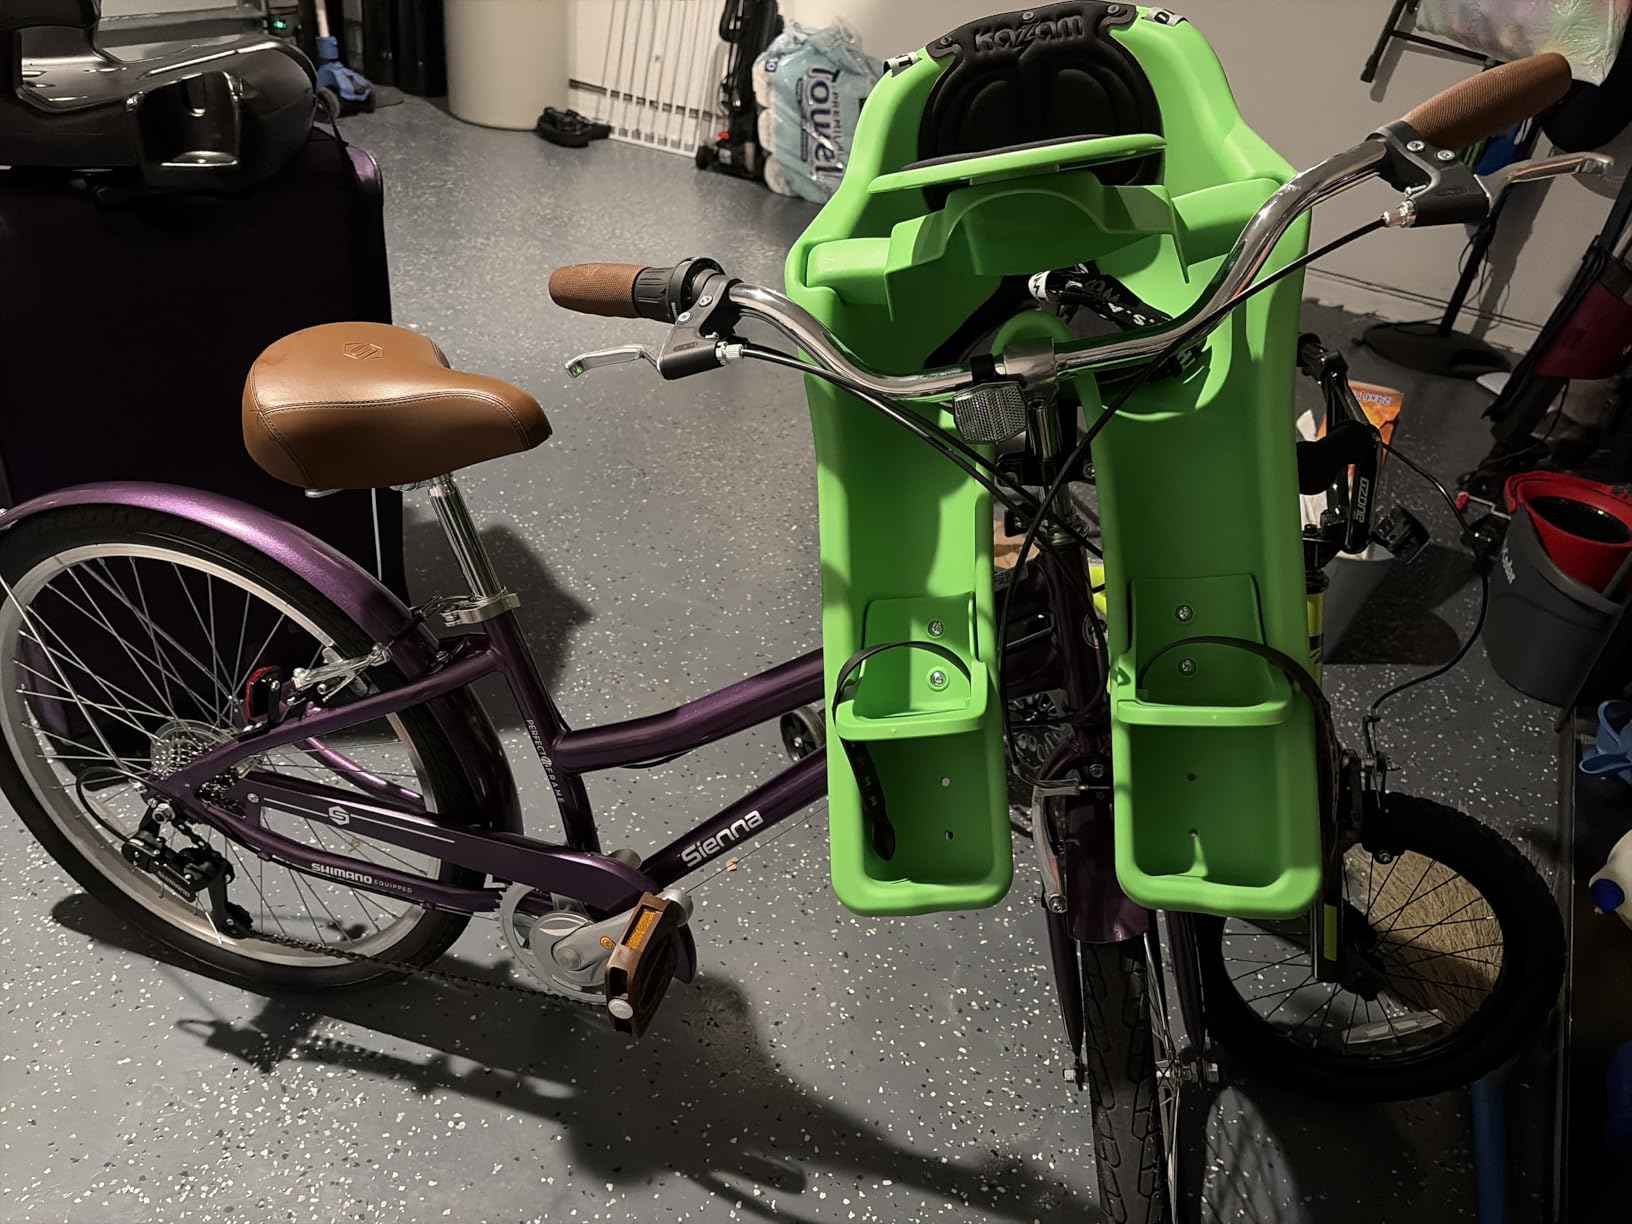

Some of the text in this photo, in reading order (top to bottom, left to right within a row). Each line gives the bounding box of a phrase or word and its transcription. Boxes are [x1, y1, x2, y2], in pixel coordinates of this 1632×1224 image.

[810, 67, 844, 174] Towel
[526, 719, 565, 804] PERFECT FRAME
[681, 810, 764, 868] Sienna
[311, 863, 413, 894] SHIMANO EQUIPPED
